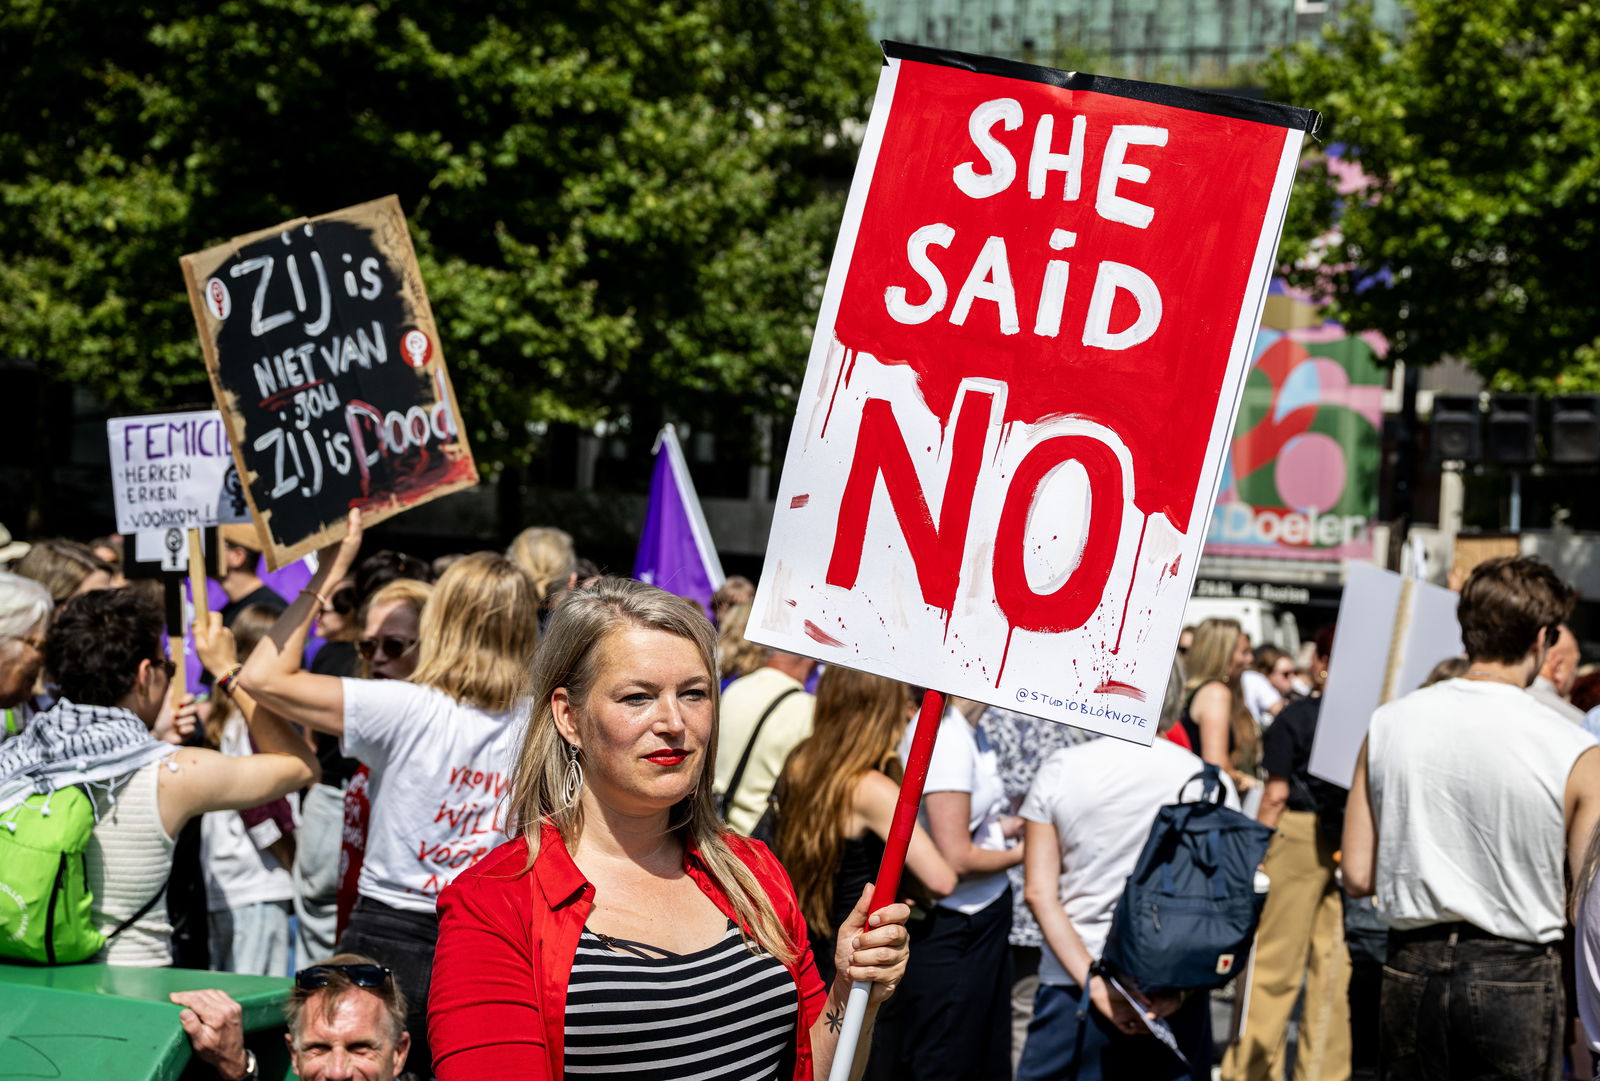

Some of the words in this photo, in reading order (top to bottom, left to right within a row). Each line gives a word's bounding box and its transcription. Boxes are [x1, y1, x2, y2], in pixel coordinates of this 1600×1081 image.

[952, 97, 1169, 229] SHE
[253, 342, 316, 398] NIET
[320, 320, 387, 376] VAN
[125, 420, 232, 461] FEMICI
[125, 464, 191, 483] HERKEN
[127, 486, 177, 504] ERKEN
[826, 389, 1123, 634] NO
